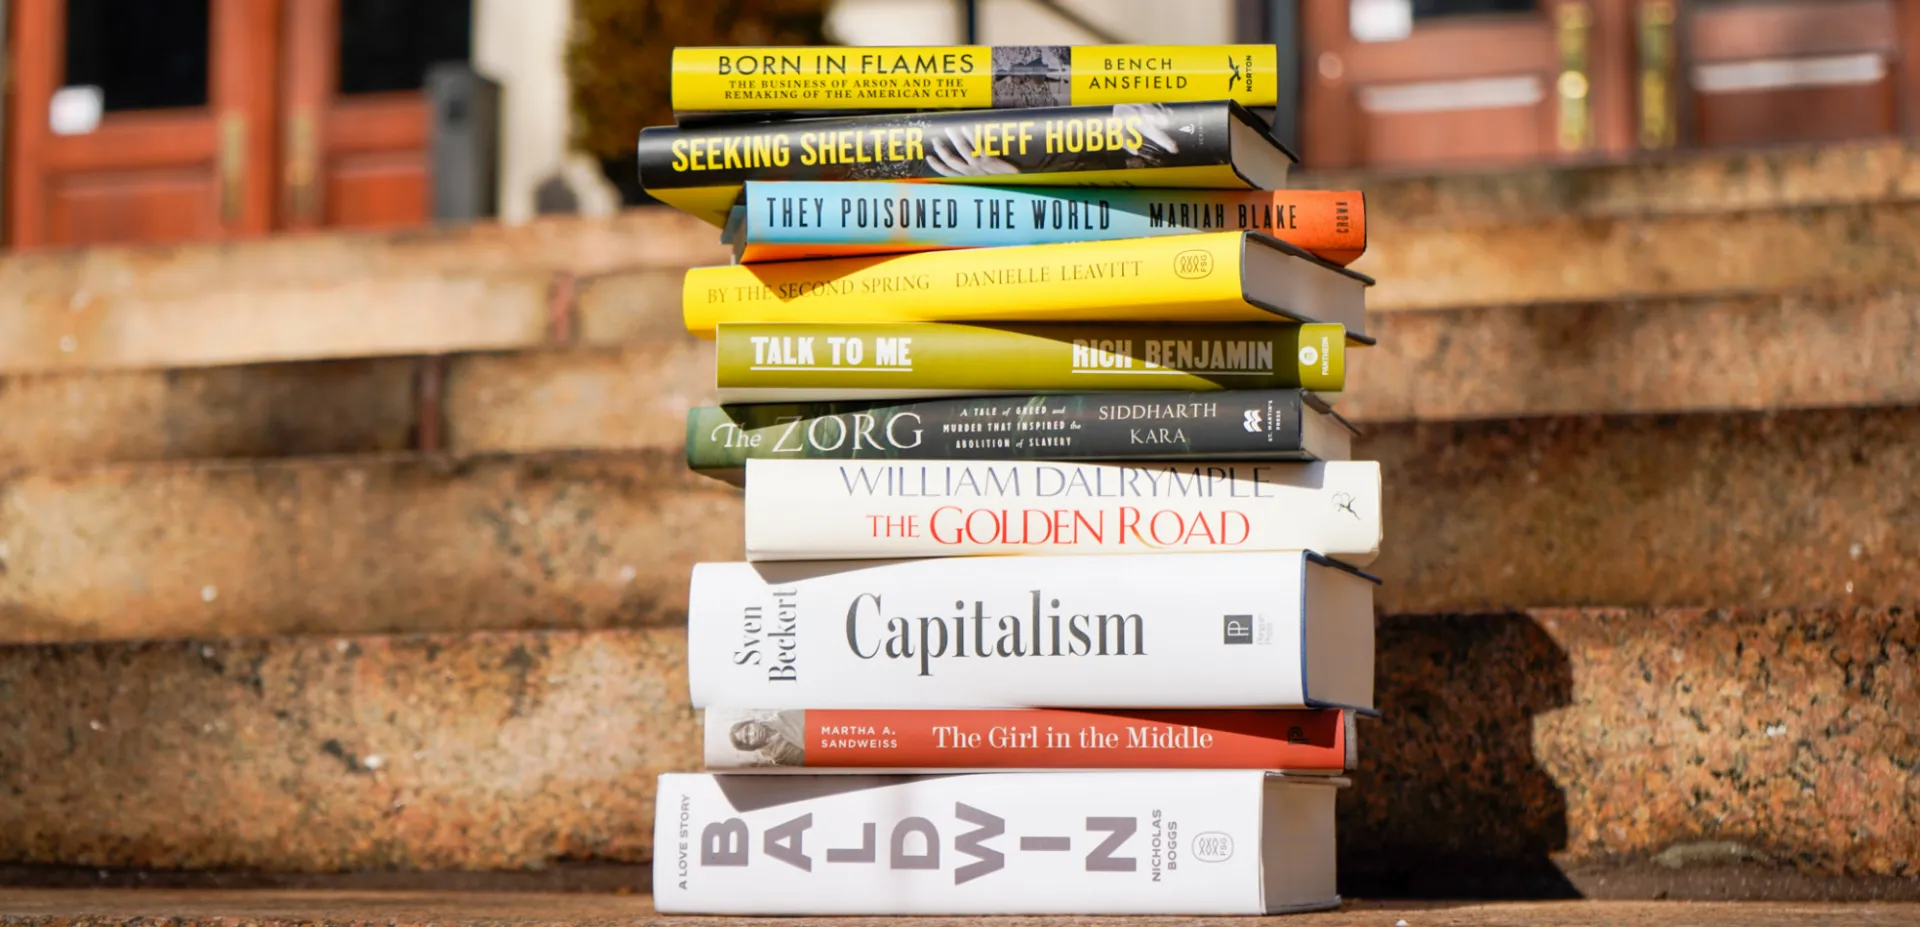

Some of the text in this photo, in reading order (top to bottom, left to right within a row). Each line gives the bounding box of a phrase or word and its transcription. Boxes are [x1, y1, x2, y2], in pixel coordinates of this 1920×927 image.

[719, 54, 975, 75] BORN IN FLAMES
[1104, 58, 1172, 71] BENCH
[725, 89, 968, 99] REMAKING OF THE AMERICAN CITY
[729, 78, 964, 89] THE BUSINESS OF ARSON AND THE
[1089, 76, 1188, 89] ANSFIELD
[672, 127, 924, 172] SEEKING SHELTER
[971, 117, 1143, 158] JEFF HOBBS
[767, 197, 1110, 231] THEY POISONED THE WORLD
[1150, 203, 1297, 230] MARIAH BLAKE
[708, 274, 930, 304] BY THE SECOND SPRING
[956, 260, 1144, 288] DANIELLE LEAVITT
[750, 336, 912, 367] TALK TO ME
[1072, 338, 1273, 370] RICH BENJAMIN
[974, 407, 997, 416] TALE
[1002, 407, 1011, 416] of
[1016, 406, 1047, 415] GREED
[1052, 406, 1066, 414] and
[1099, 403, 1217, 420] SIDDHARTH
[711, 412, 924, 453] The ZORG
[943, 421, 1081, 433] MURDER THAT INSPIRED the
[1130, 428, 1186, 444] KARA
[956, 437, 1071, 449] ABOLITION of SLAVERY
[840, 466, 1274, 498] WILLIAM DALRYMPLE
[866, 506, 1250, 549] THE GOLDEN ROAD
[733, 605, 762, 666] Sven
[767, 588, 797, 683] Beckert
[846, 590, 1148, 676] Capitalism
[821, 726, 896, 736] MARTHA A.
[821, 739, 898, 748] SANDWEISS
[932, 726, 1213, 749] The Girl in the Middle
[678, 794, 691, 890] A LOVE STORY
[700, 801, 1137, 886] BALDWIN
[1152, 809, 1162, 882] NICHOLAS
[1168, 821, 1177, 870] BOGGS
